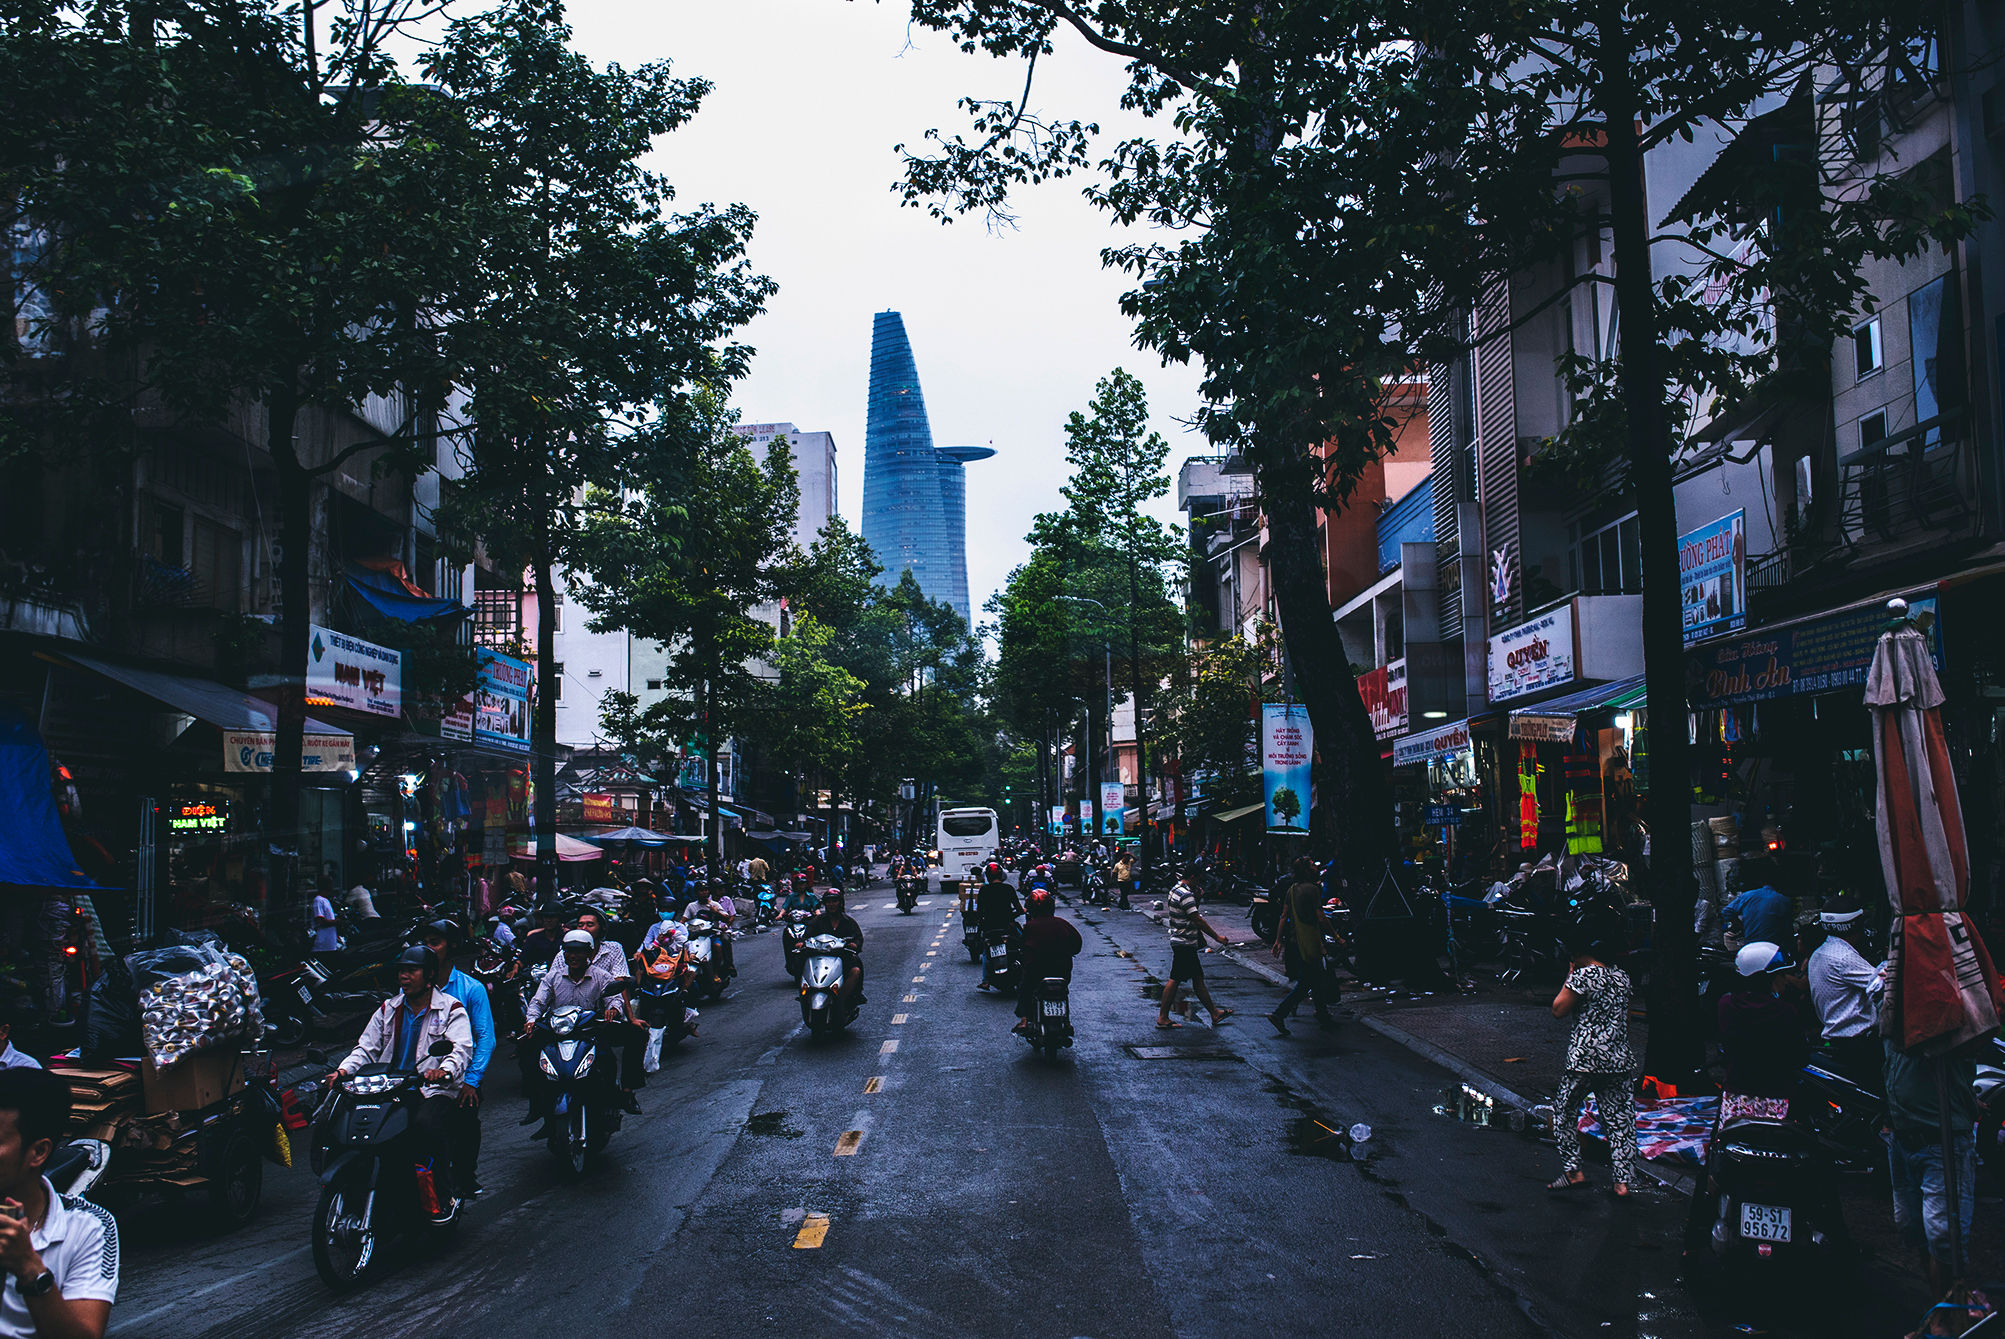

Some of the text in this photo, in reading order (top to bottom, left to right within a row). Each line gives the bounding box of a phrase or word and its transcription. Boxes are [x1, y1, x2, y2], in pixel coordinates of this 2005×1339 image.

[1680, 524, 1731, 573] ƯỜNG PHÁT
[1507, 634, 1549, 669] QUYỀN
[335, 662, 360, 687] NAM
[362, 669, 386, 697] VIỆT
[230, 736, 255, 745] CHUYÊN
[256, 736, 266, 745] BÁN
[307, 738, 322, 748] RUỘT
[1434, 727, 1467, 750] QUYỀN
[182, 805, 216, 816] ĐIỆN
[173, 816, 226, 829] NAM VIỆT
[1749, 1206, 1783, 1224] 59-S1
[1744, 1221, 1788, 1240] 956.72
